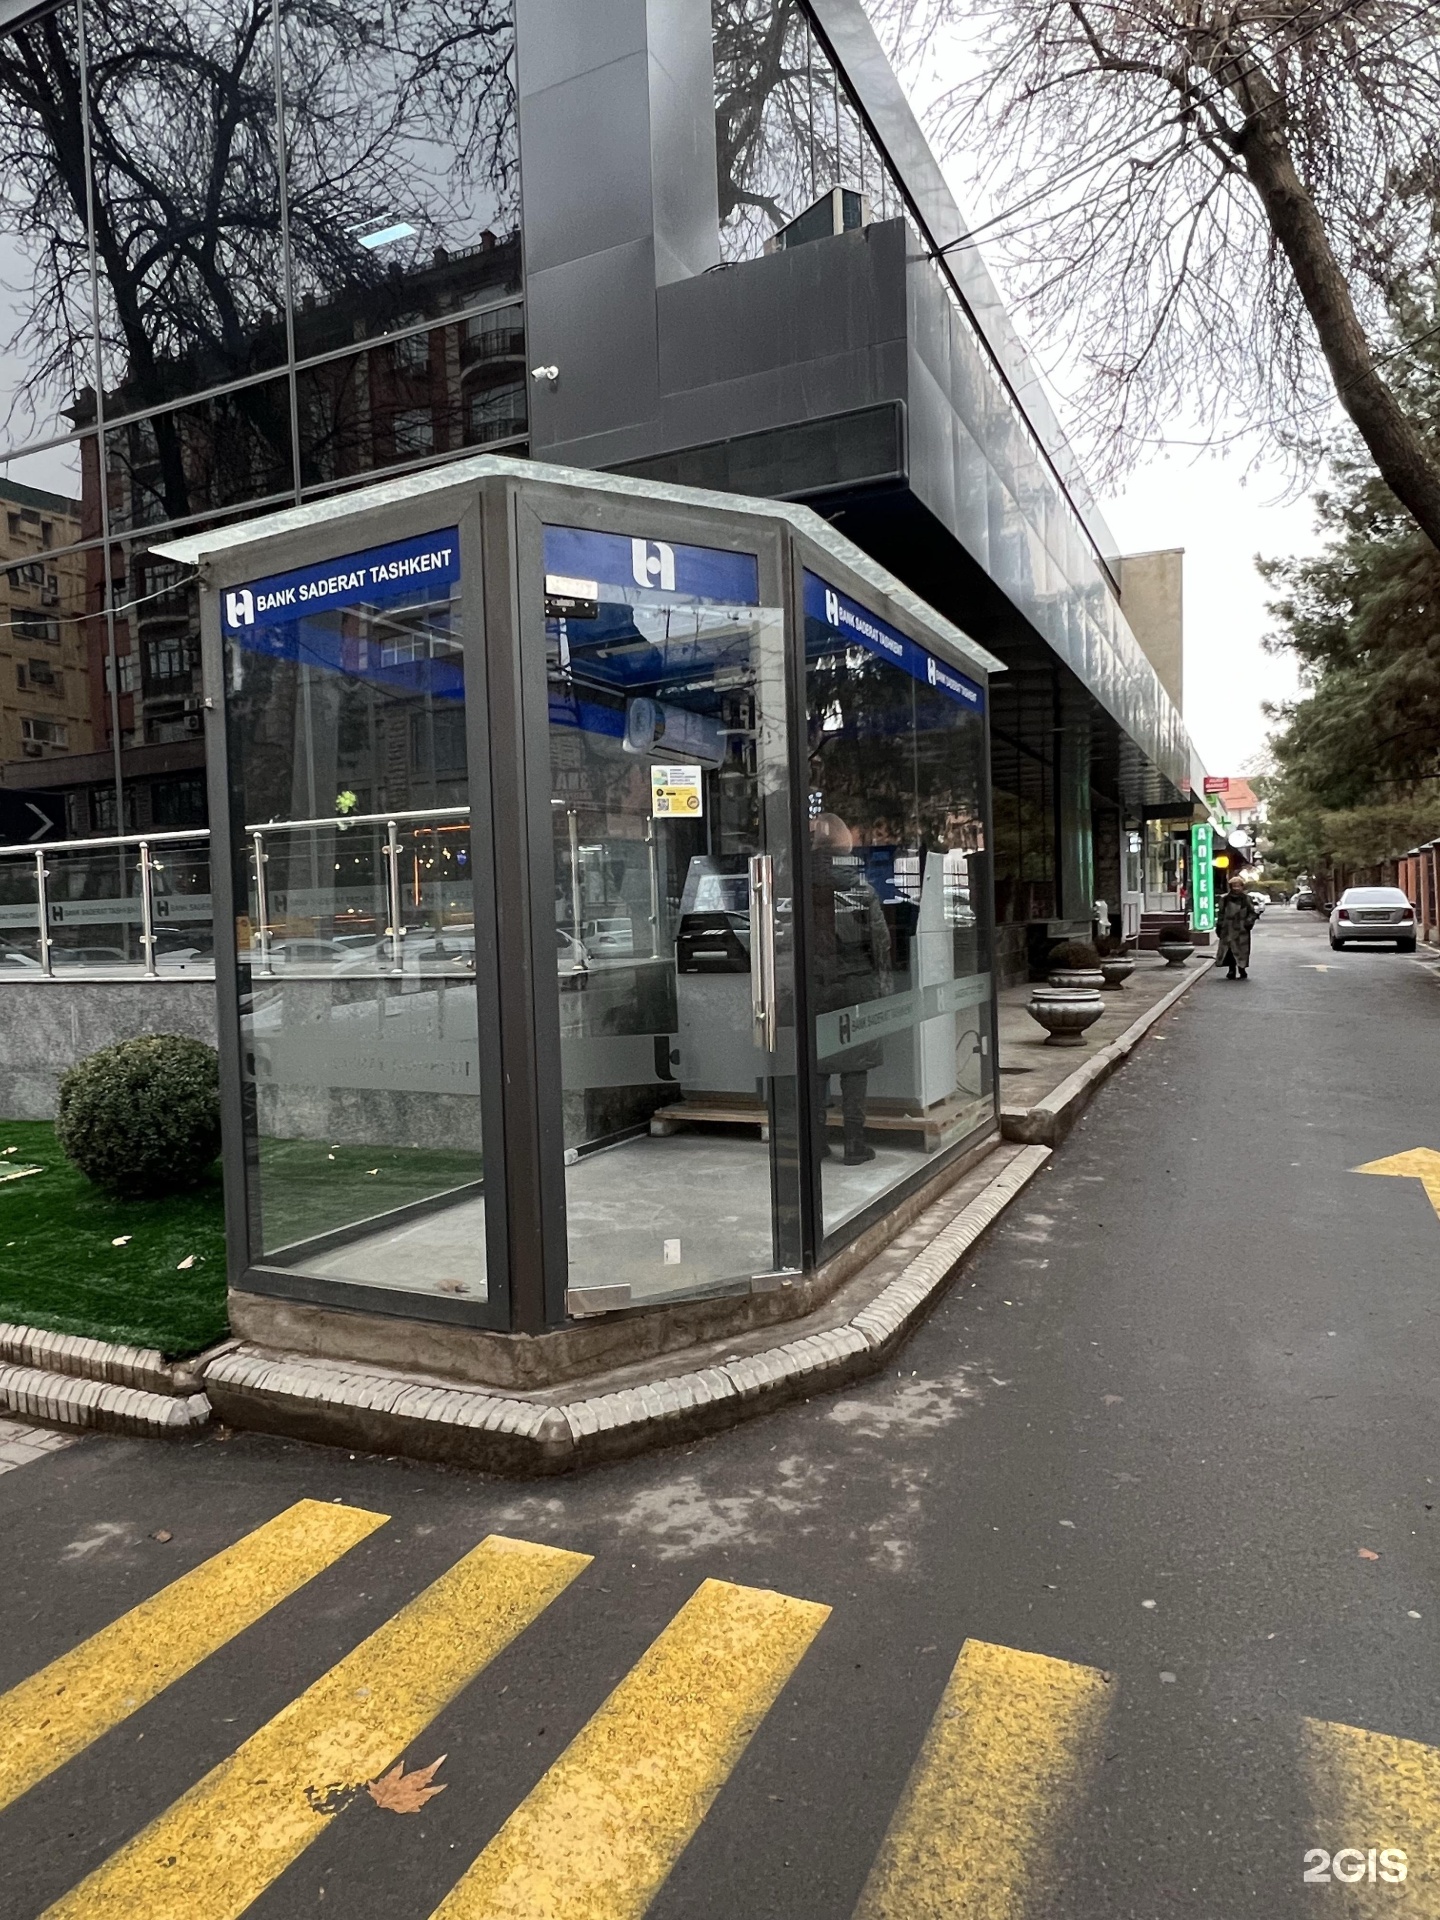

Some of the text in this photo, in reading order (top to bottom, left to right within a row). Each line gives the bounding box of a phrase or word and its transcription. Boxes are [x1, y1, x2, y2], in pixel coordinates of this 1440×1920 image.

[257, 549, 452, 612] BANK SADERAT TASHKENT
[1197, 827, 1209, 927] АПТЕКА
